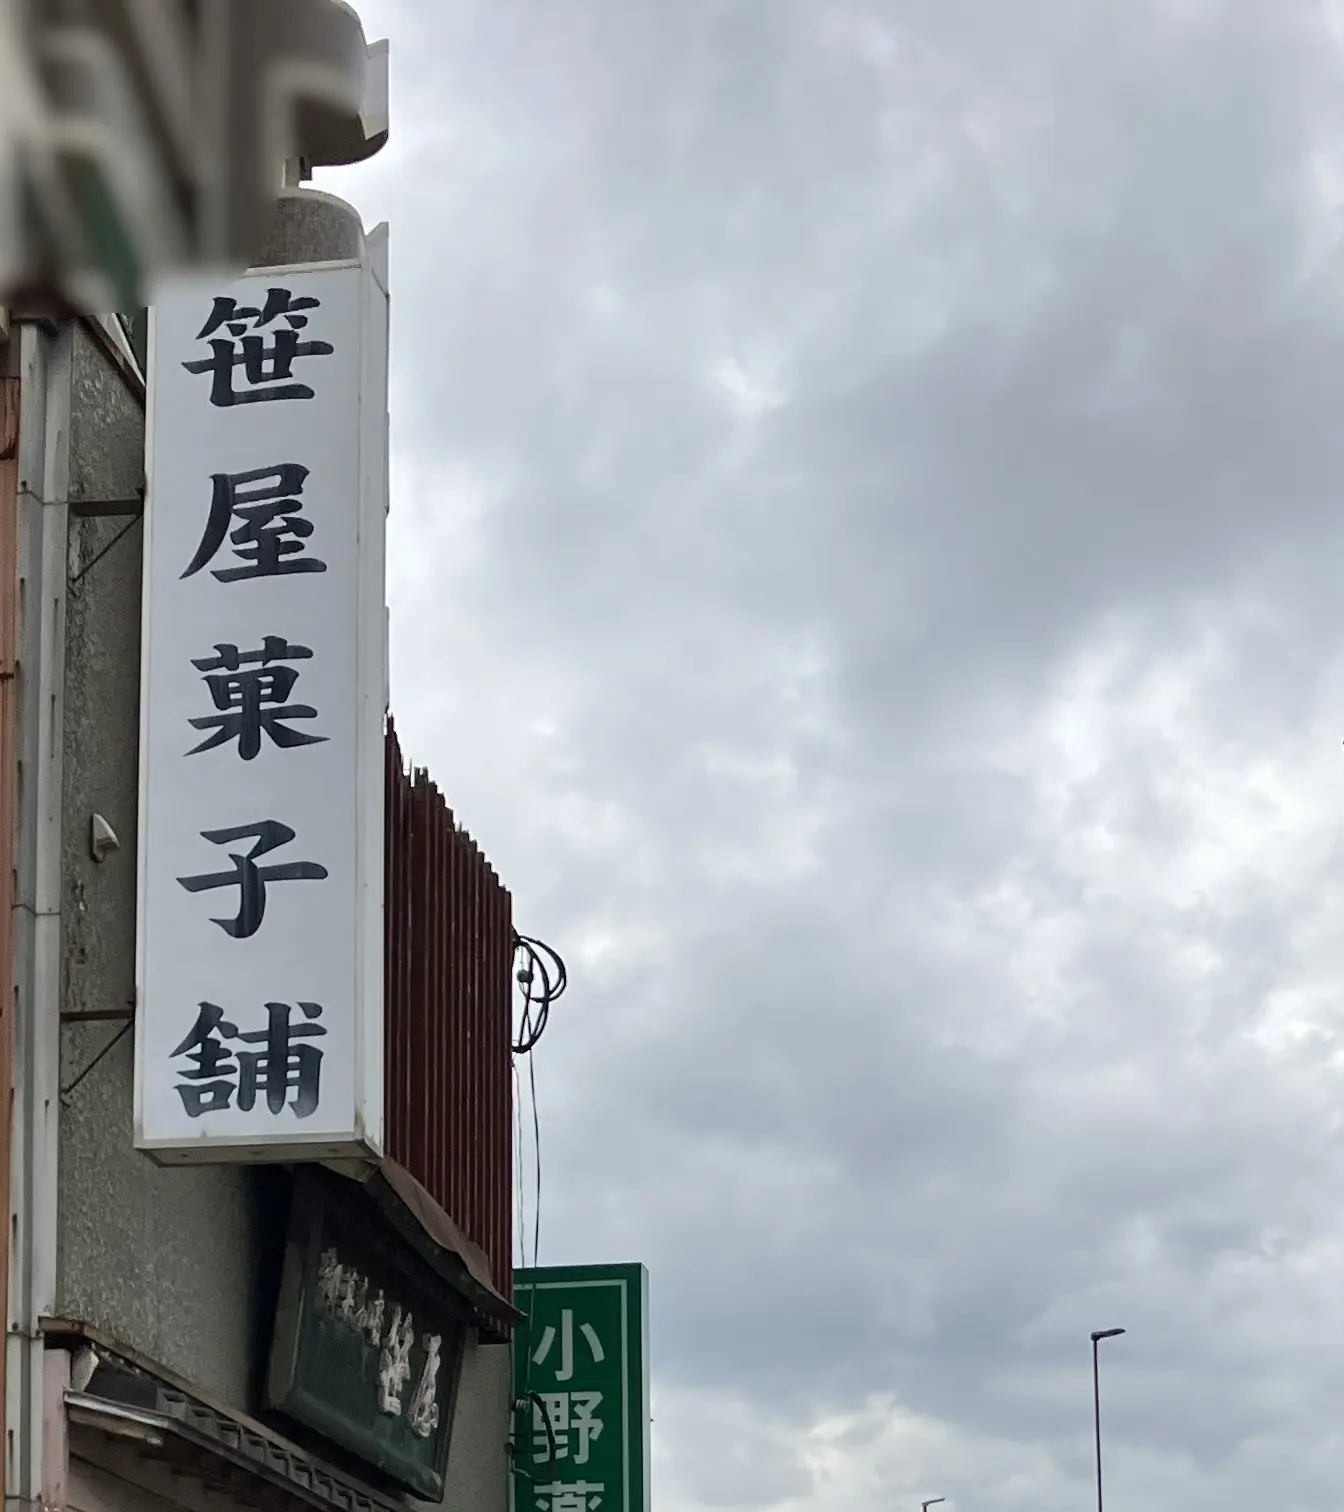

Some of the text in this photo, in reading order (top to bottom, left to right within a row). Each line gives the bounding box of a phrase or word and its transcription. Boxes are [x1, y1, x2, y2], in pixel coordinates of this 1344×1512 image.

[169, 287, 334, 1119] 笹屋菓子舗
